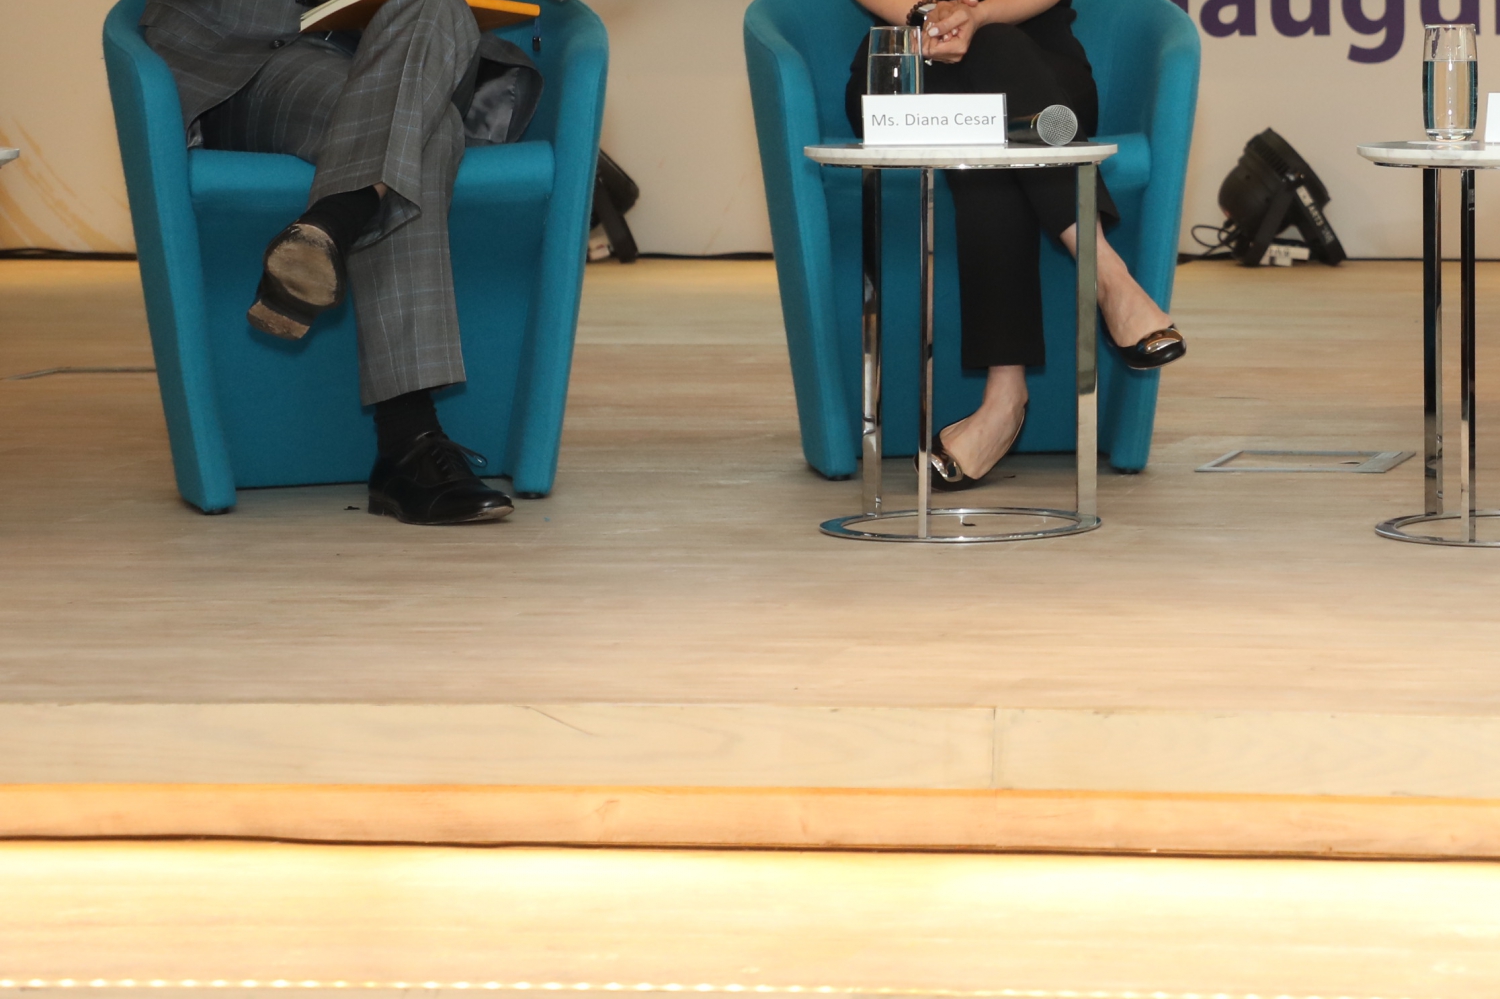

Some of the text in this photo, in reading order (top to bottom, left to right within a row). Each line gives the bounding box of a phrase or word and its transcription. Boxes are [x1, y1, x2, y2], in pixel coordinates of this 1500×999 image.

[871, 112, 997, 127] Ms. Diana Cesar
